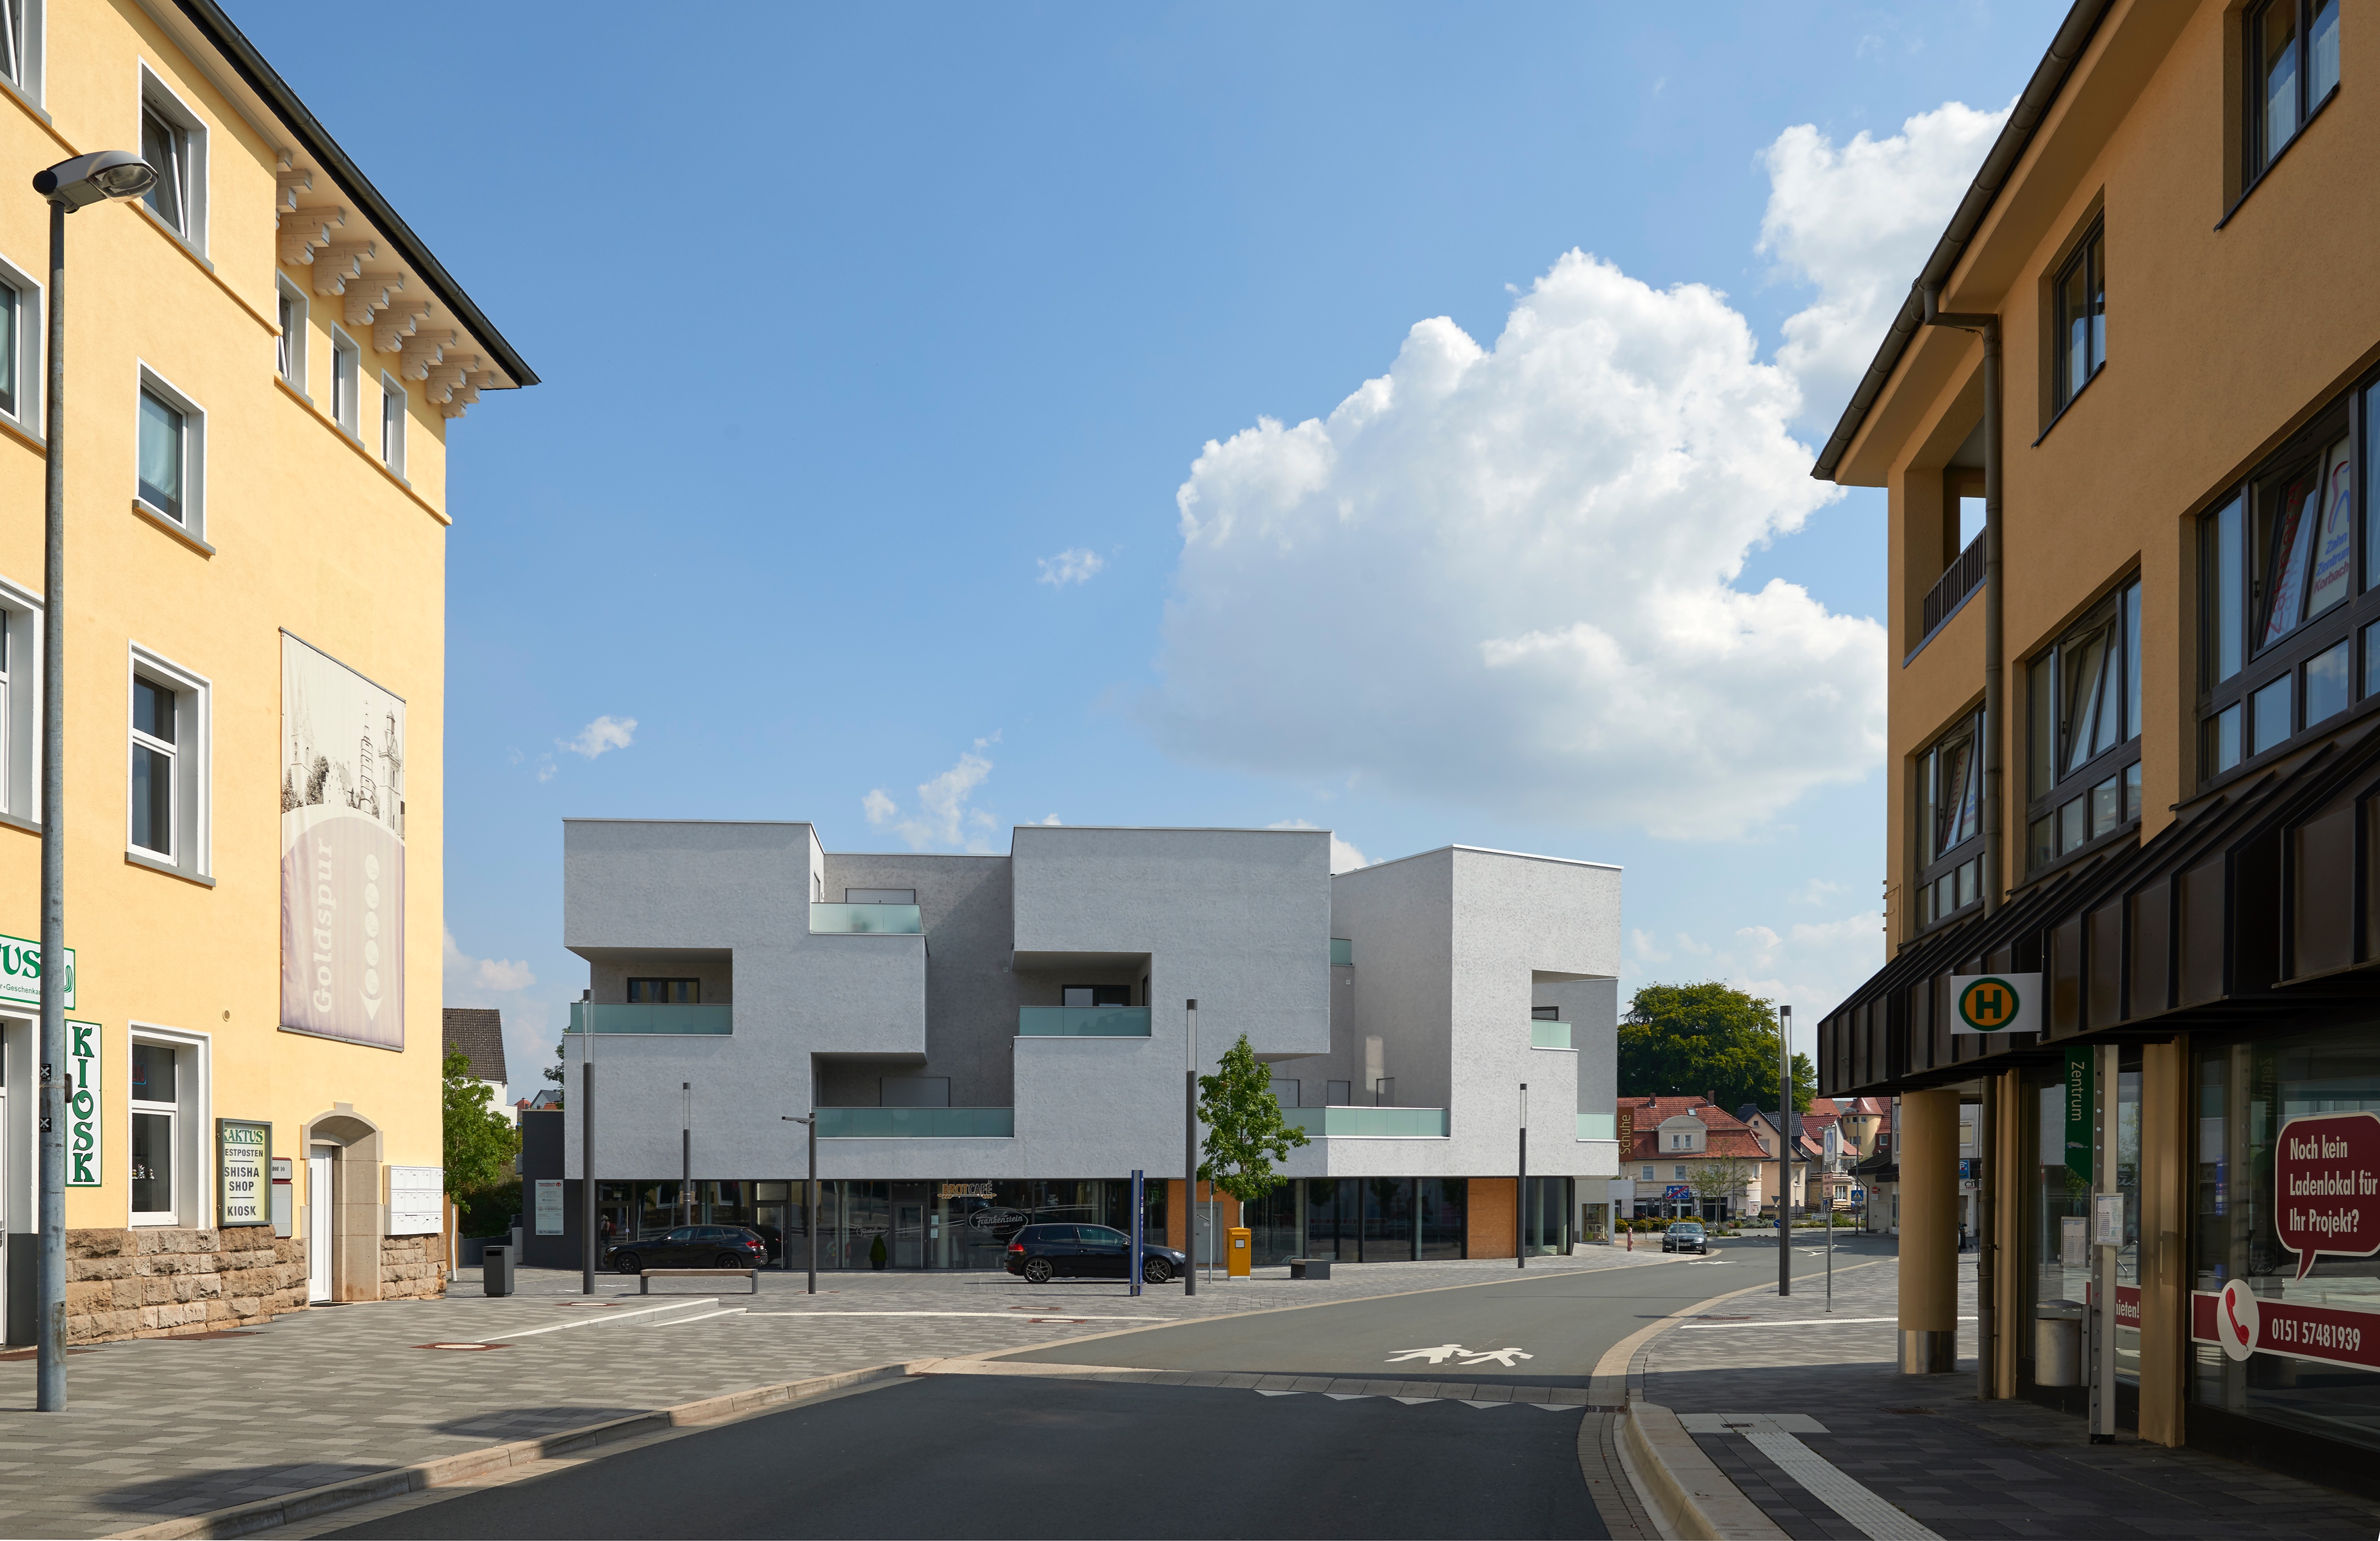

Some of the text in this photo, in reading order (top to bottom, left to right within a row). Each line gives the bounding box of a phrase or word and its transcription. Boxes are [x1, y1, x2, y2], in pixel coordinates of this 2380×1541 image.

[2325, 532, 2347, 555] Zahn
[2314, 561, 2349, 594] Korbach
[313, 837, 336, 1013] Goldspur
[0, 943, 40, 978] US
[72, 1026, 94, 1182] KIOSK
[2071, 1062, 2085, 1121] Zentrum
[1619, 1115, 1631, 1154] Schuhe
[2290, 1134, 2347, 1160] Noch kein
[225, 1166, 259, 1177] SHISHA
[2290, 1170, 2378, 1196] Ladenlokal für
[229, 1181, 254, 1191] SHOP
[942, 1181, 992, 1194] BROTCAFÉ
[228, 1206, 256, 1216] KIOSK
[976, 1215, 1023, 1229] Frankenstein
[2290, 1208, 2359, 1237] Ihr Projekt?
[2272, 1318, 2361, 1351] 0151 57481939
